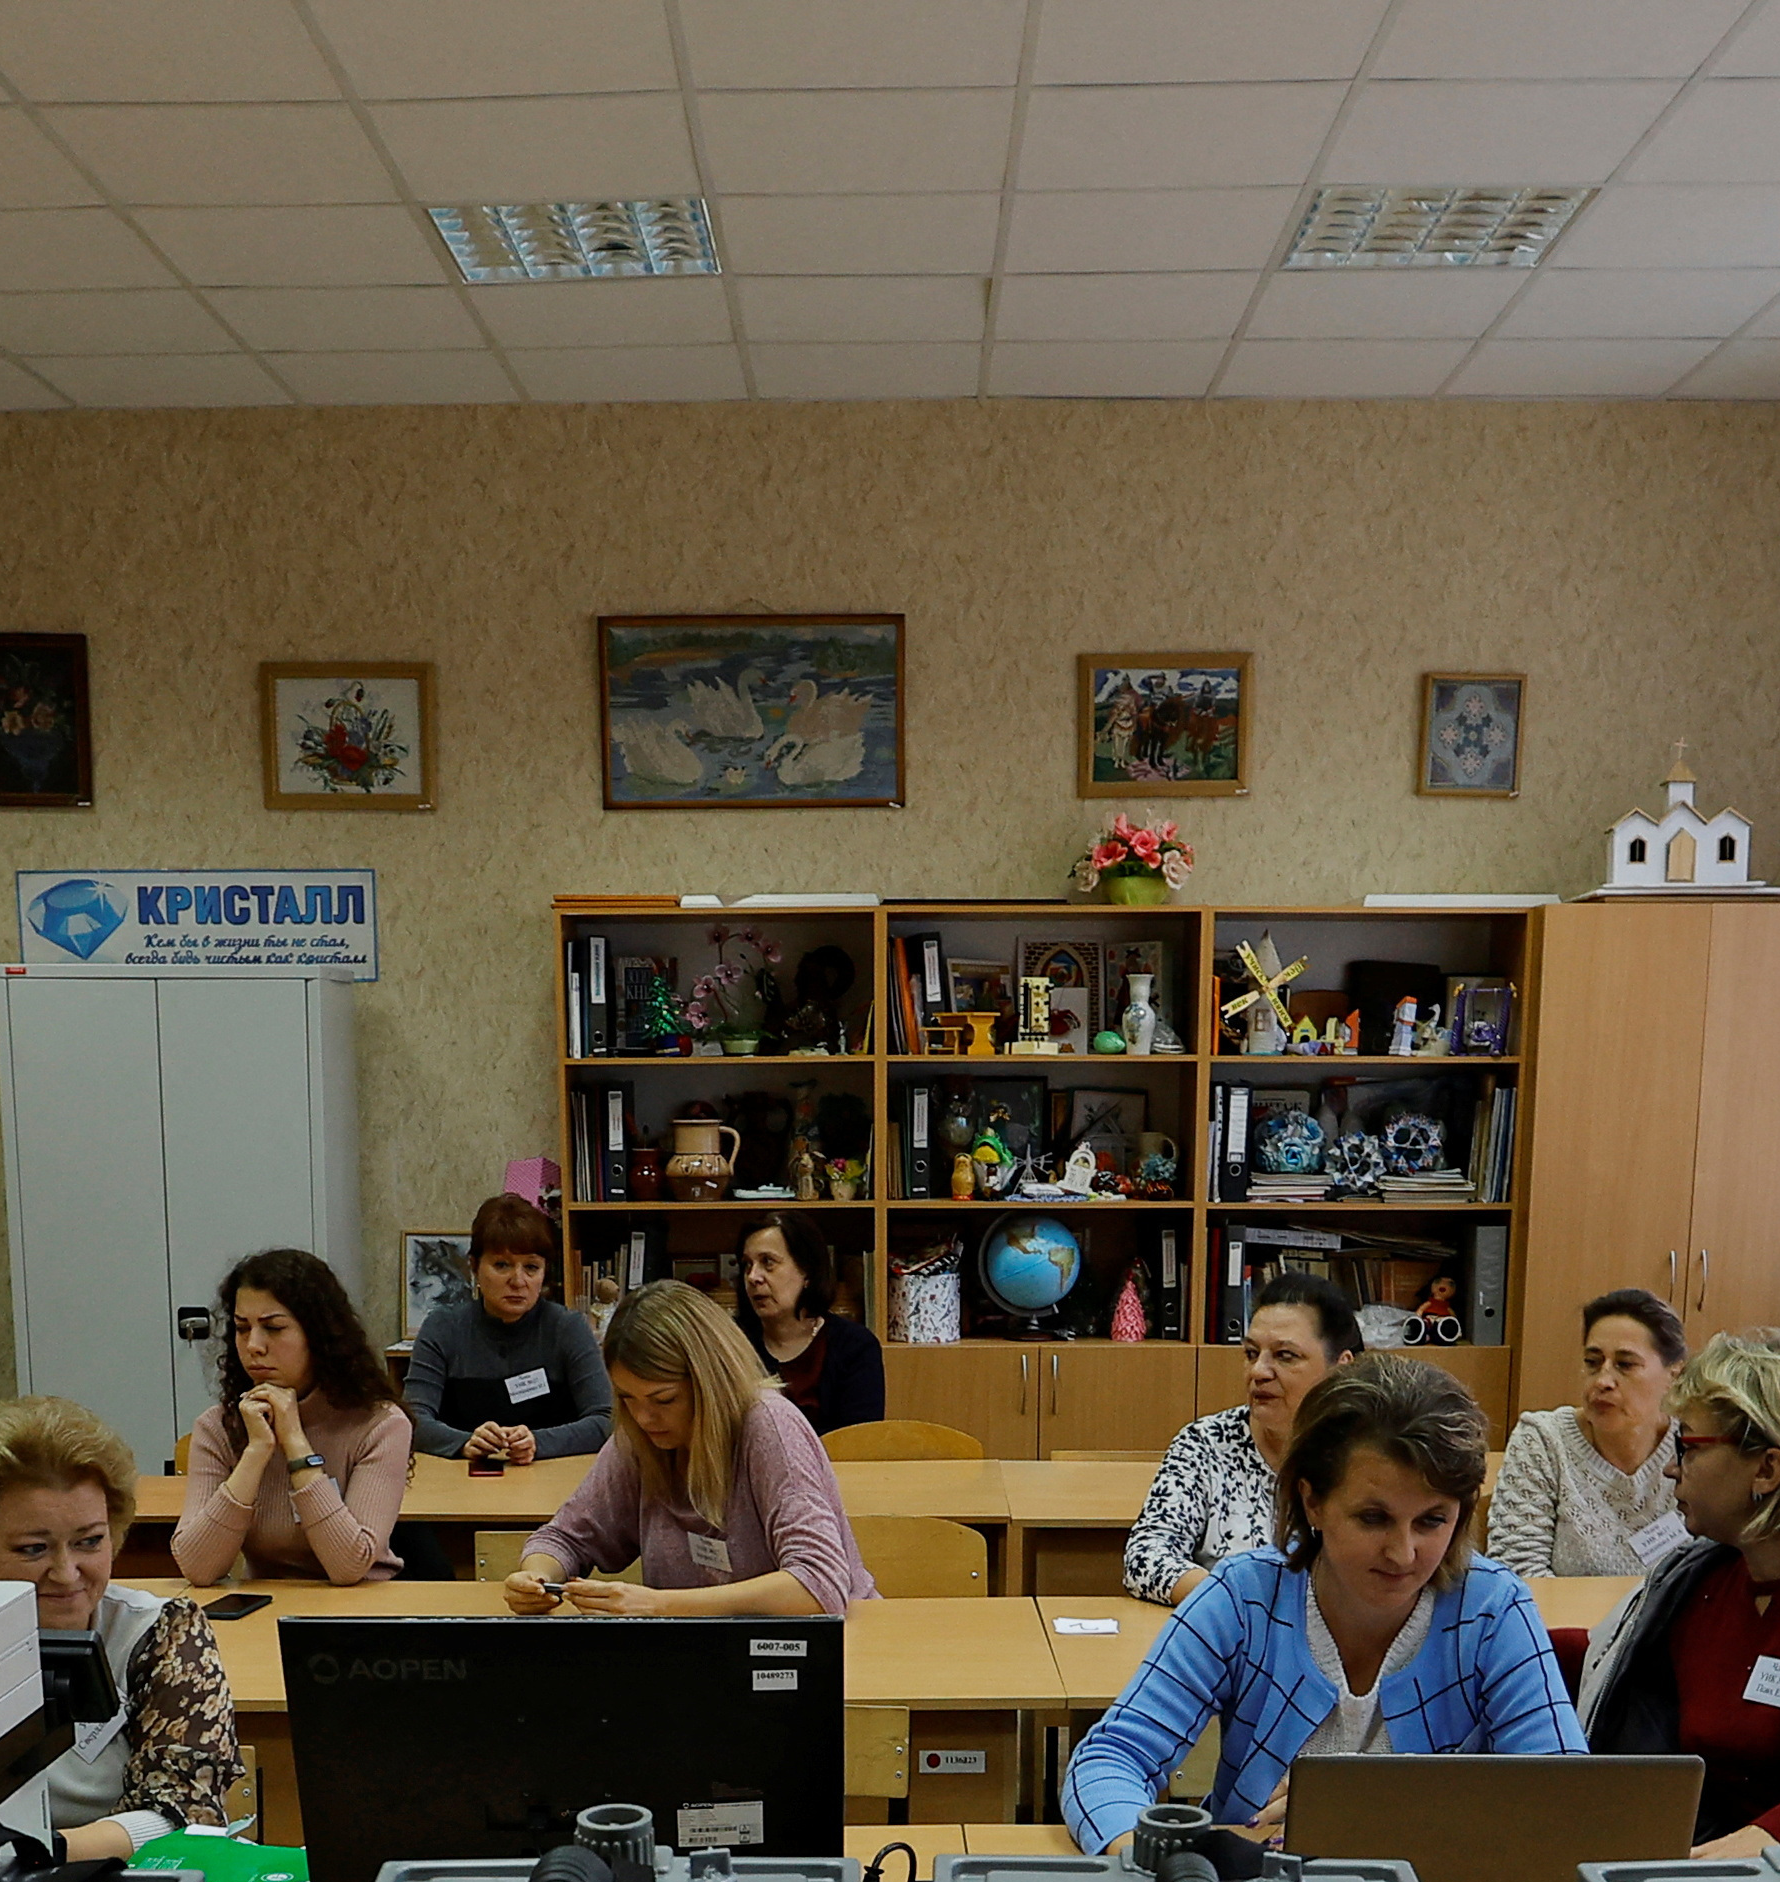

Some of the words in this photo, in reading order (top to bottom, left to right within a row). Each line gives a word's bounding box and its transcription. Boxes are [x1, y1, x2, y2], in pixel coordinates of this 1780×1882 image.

[137, 886, 364, 924] КРИСТАЛЛ
[144, 933, 175, 948] Кем
[179, 933, 198, 948] бы
[202, 934, 211, 948] в
[214, 937, 260, 952] жизни
[264, 935, 288, 948] ты
[292, 937, 307, 948] не
[125, 950, 168, 964] всегда
[204, 951, 262, 965] чистым
[266, 952, 293, 965] как
[296, 951, 367, 966] кристалл
[756, 1642, 801, 1652] 6007-005
[348, 1658, 468, 1681] AOPEN
[756, 1672, 795, 1680] 10489273
